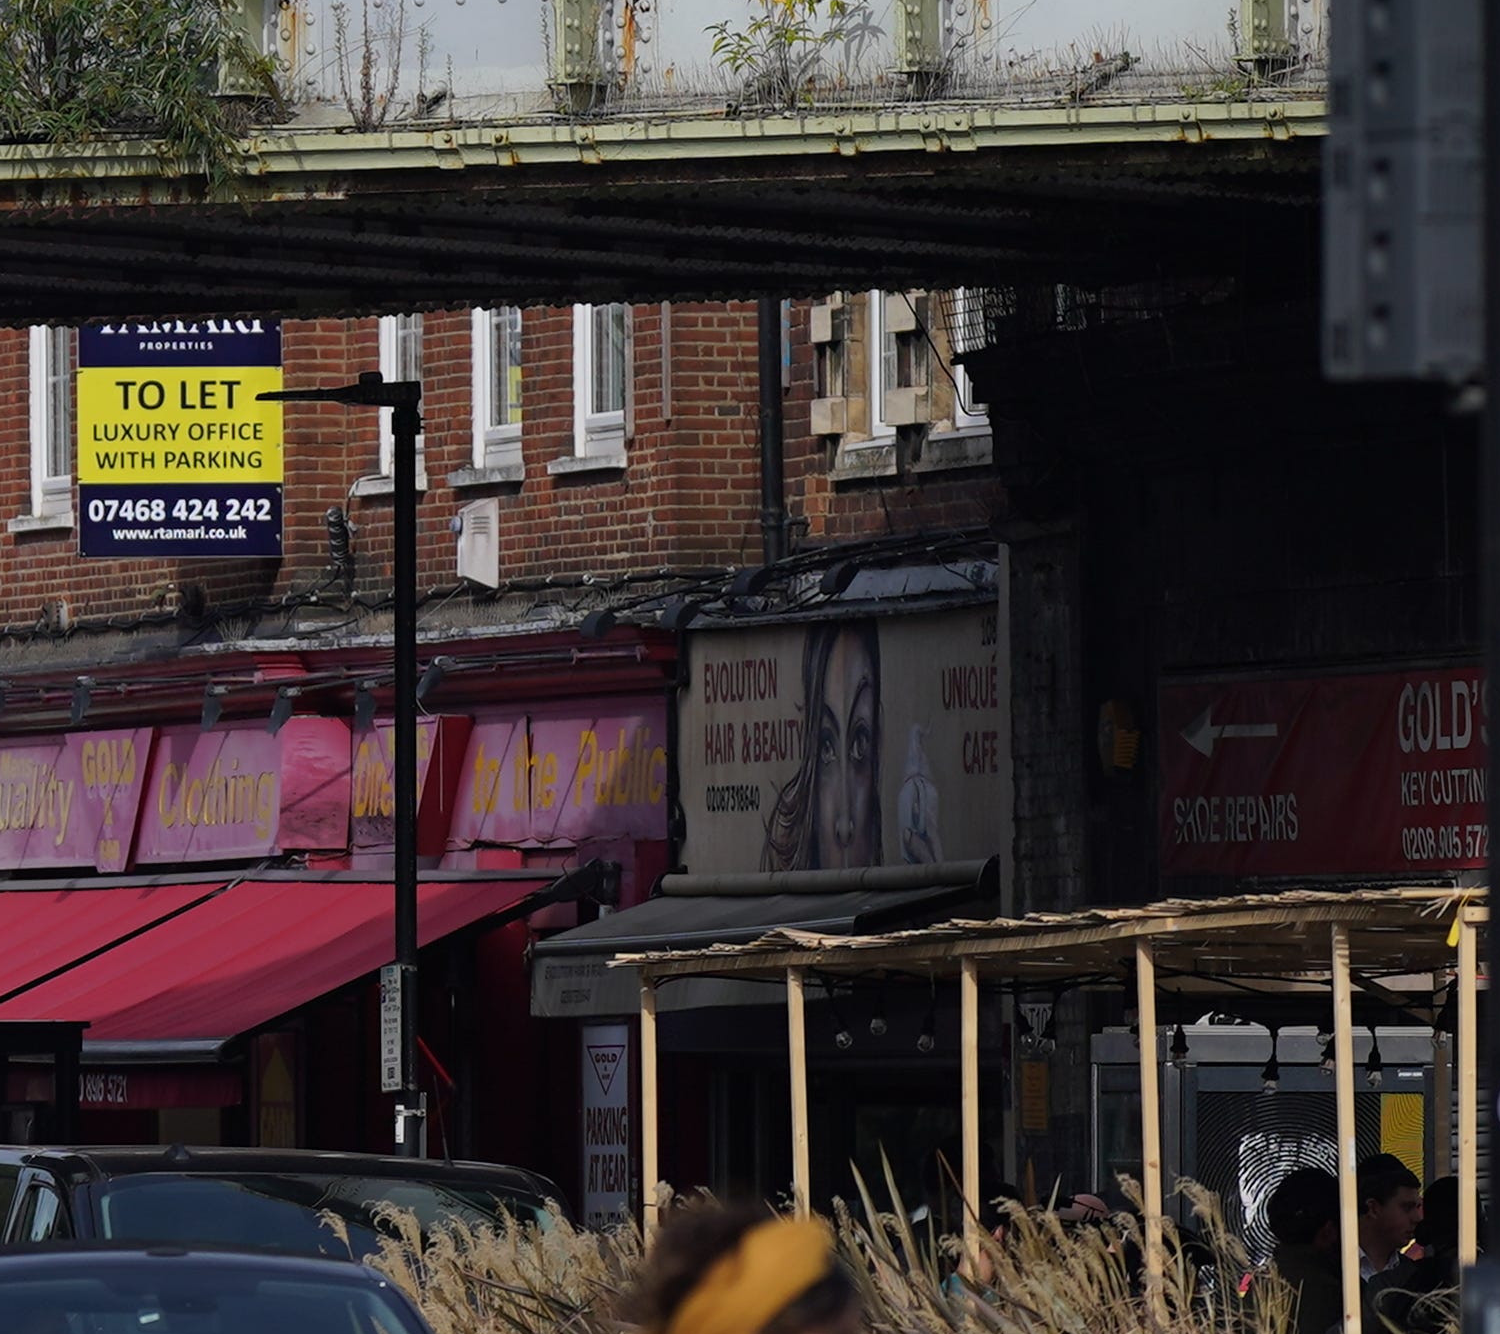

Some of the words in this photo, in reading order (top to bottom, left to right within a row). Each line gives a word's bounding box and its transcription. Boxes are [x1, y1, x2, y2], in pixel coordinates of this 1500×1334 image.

[139, 341, 214, 351] PROPERTIES
[115, 380, 166, 411] TO
[180, 380, 242, 411] LET
[92, 423, 181, 442] LUXURY
[187, 422, 265, 441] OFFICE
[95, 451, 156, 470] WITH
[164, 450, 263, 469] PARKING
[87, 498, 167, 522] 07468
[171, 498, 220, 521] 424
[224, 498, 272, 521] 242
[112, 525, 248, 541] www.rtamari.co.uk
[703, 658, 779, 704] EVOLUTION
[704, 722, 736, 766] HAIR
[741, 722, 752, 764] &
[753, 718, 806, 763] BEAUTY
[962, 730, 999, 774] CAFE
[81, 739, 137, 786] GOLD
[158, 758, 276, 840] Clothing
[473, 742, 501, 814] to
[513, 733, 558, 812] the
[574, 727, 666, 808] Public
[1401, 771, 1427, 807] KEY
[1430, 767, 1489, 806] CUTTIN
[1173, 796, 1221, 845] SHOE
[1223, 791, 1299, 844] REPAIRS
[1401, 825, 1437, 861] 0208
[1438, 824, 1463, 860] 905
[594, 1053, 618, 1063] GOLD
[586, 1106, 628, 1146] PARKING
[588, 1154, 600, 1193] AT
[601, 1153, 627, 1193] REAR
